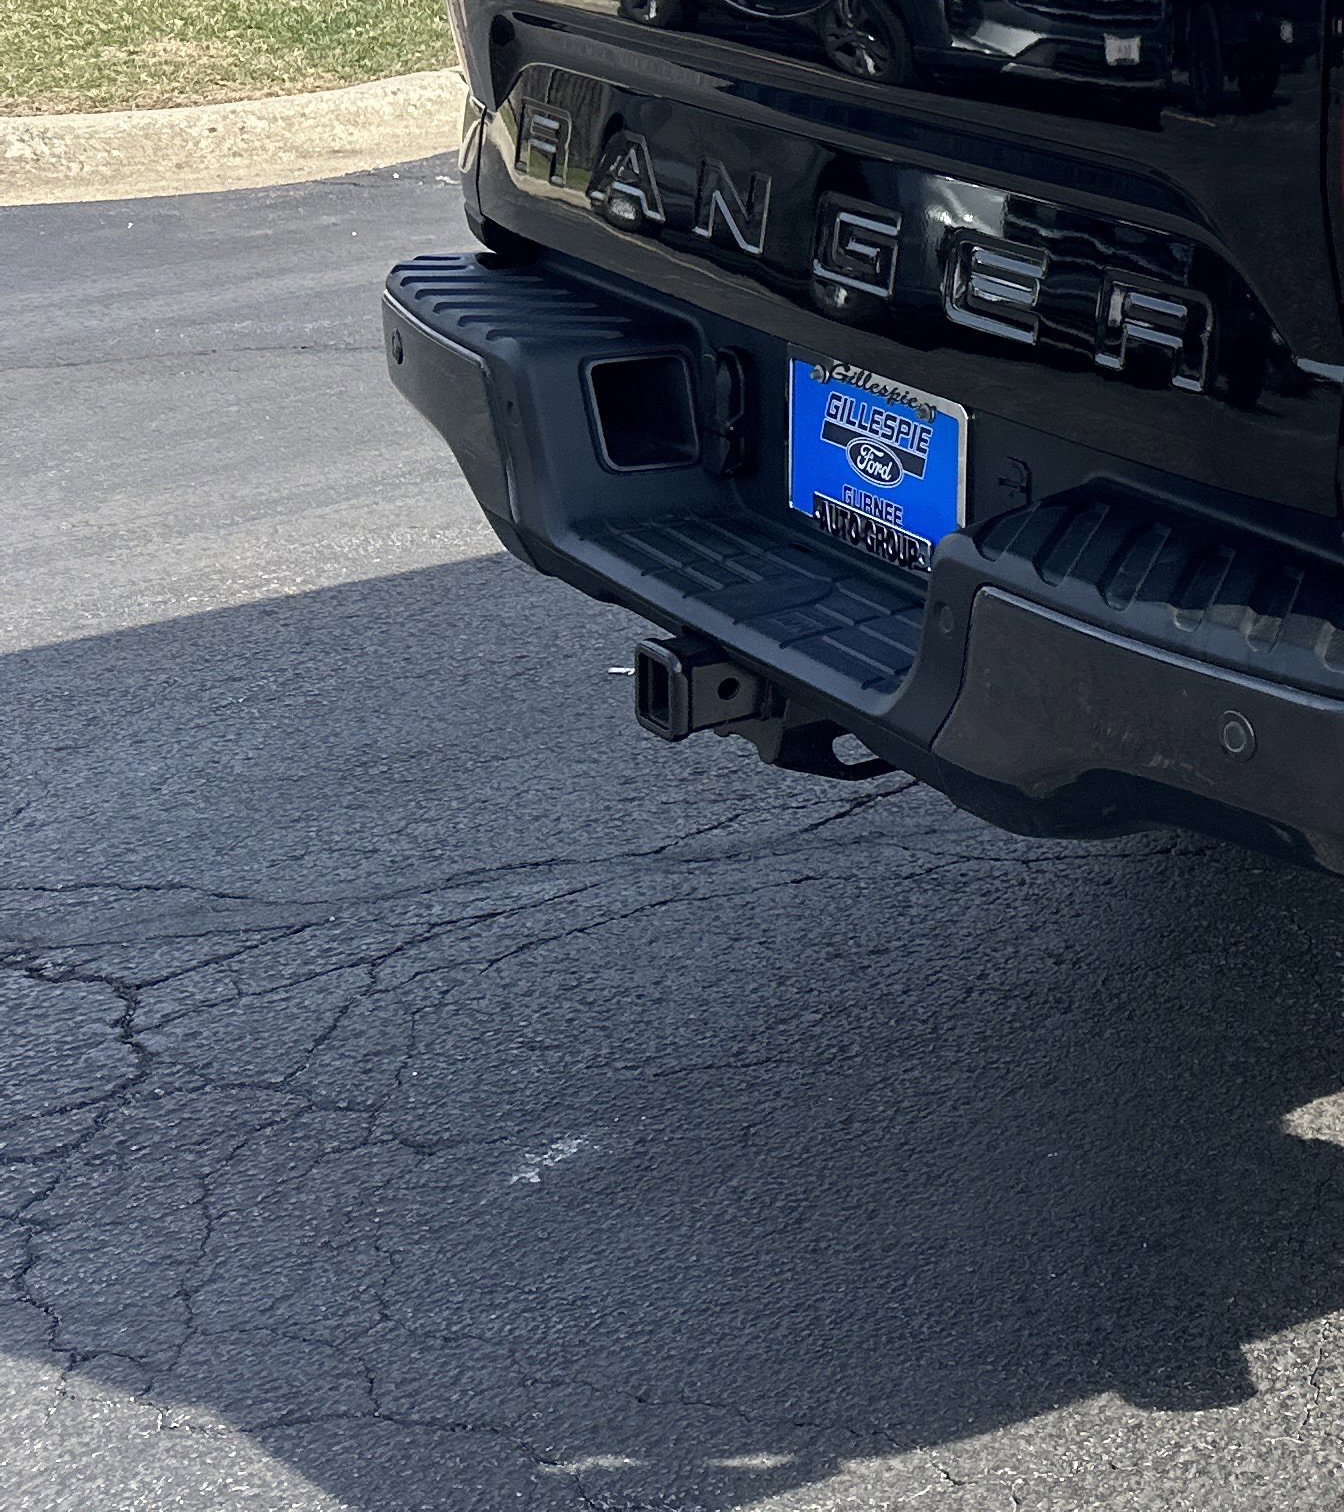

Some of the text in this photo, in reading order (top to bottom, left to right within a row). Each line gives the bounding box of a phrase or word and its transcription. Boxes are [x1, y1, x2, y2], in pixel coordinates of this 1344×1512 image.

[514, 96, 1214, 391] RANGER
[828, 363, 923, 410] Gillespie
[824, 391, 933, 457] GILLESPIE
[856, 443, 893, 481] Ford
[841, 484, 904, 526] GURNEE
[820, 500, 921, 570] AUTO GROUP
